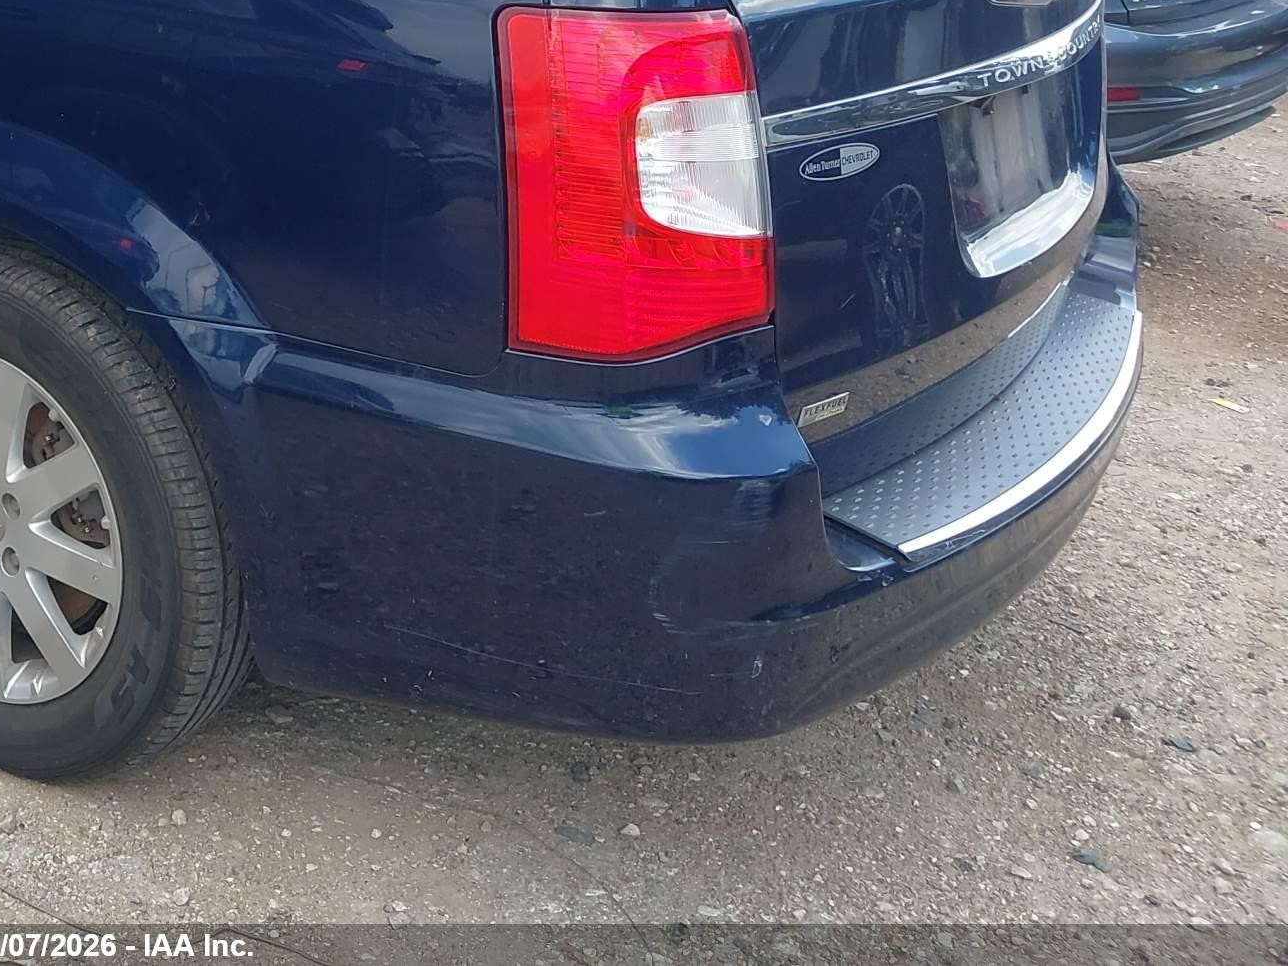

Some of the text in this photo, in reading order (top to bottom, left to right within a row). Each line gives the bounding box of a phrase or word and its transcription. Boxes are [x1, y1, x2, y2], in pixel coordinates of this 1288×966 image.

[976, 54, 1046, 88] TOWN
[805, 150, 873, 175] Allen Turner CHEVROLET
